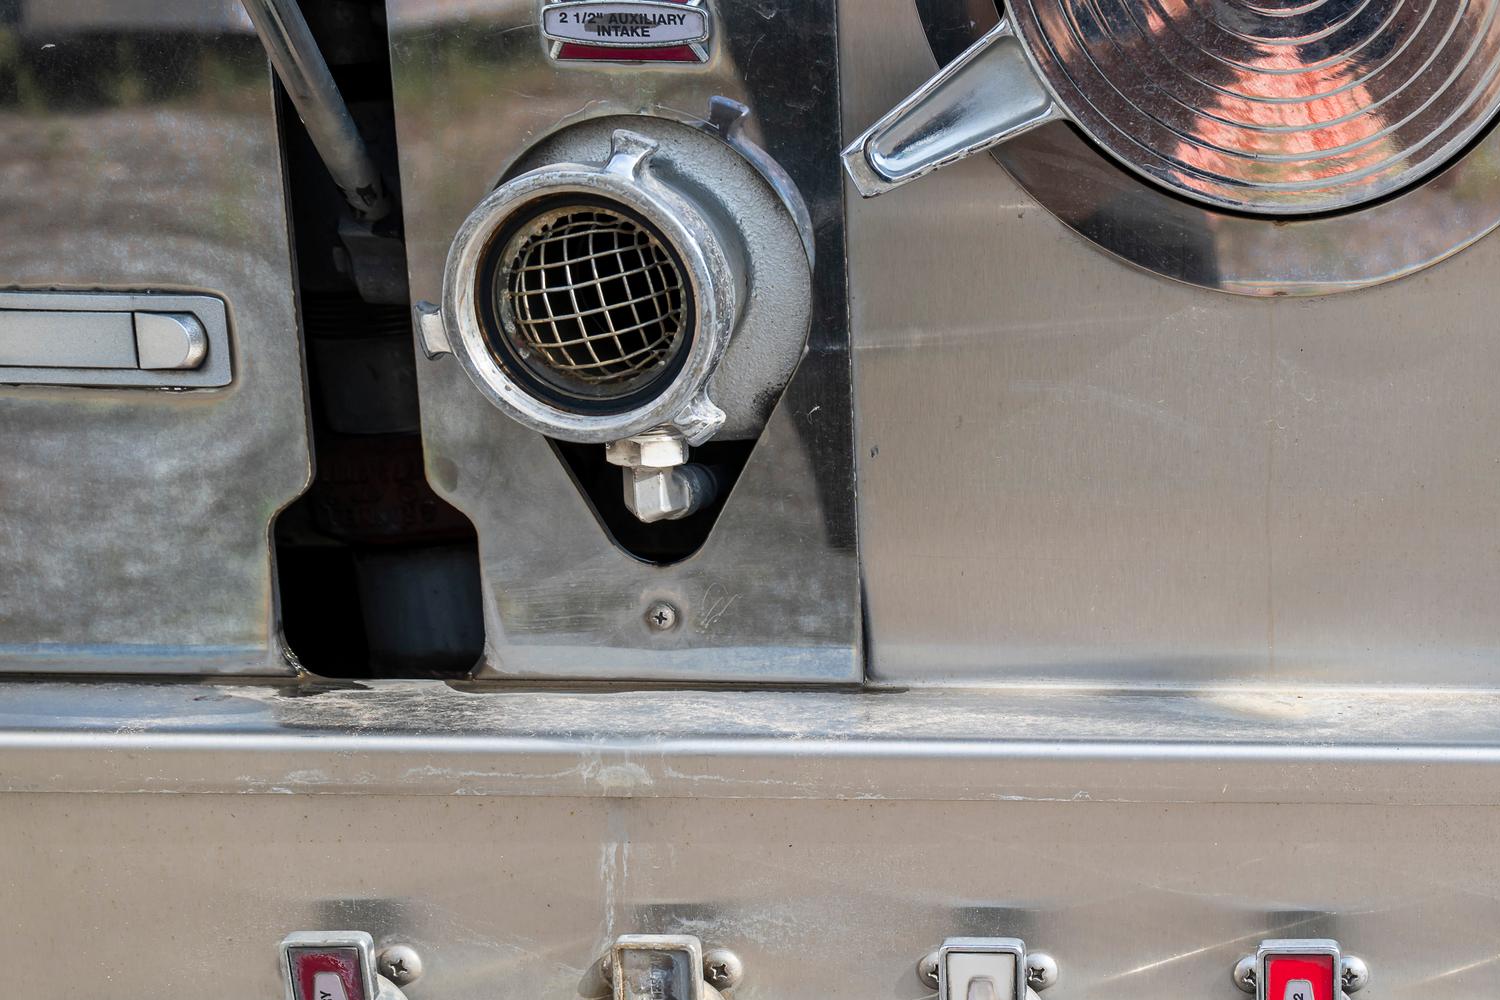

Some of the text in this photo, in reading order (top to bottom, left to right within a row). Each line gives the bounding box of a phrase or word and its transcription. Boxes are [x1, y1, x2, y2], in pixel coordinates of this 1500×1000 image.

[559, 12, 686, 26] 2 1/2" AUXILIARY
[597, 25, 651, 37] INTAKE
[1293, 992, 1304, 1000] 2
